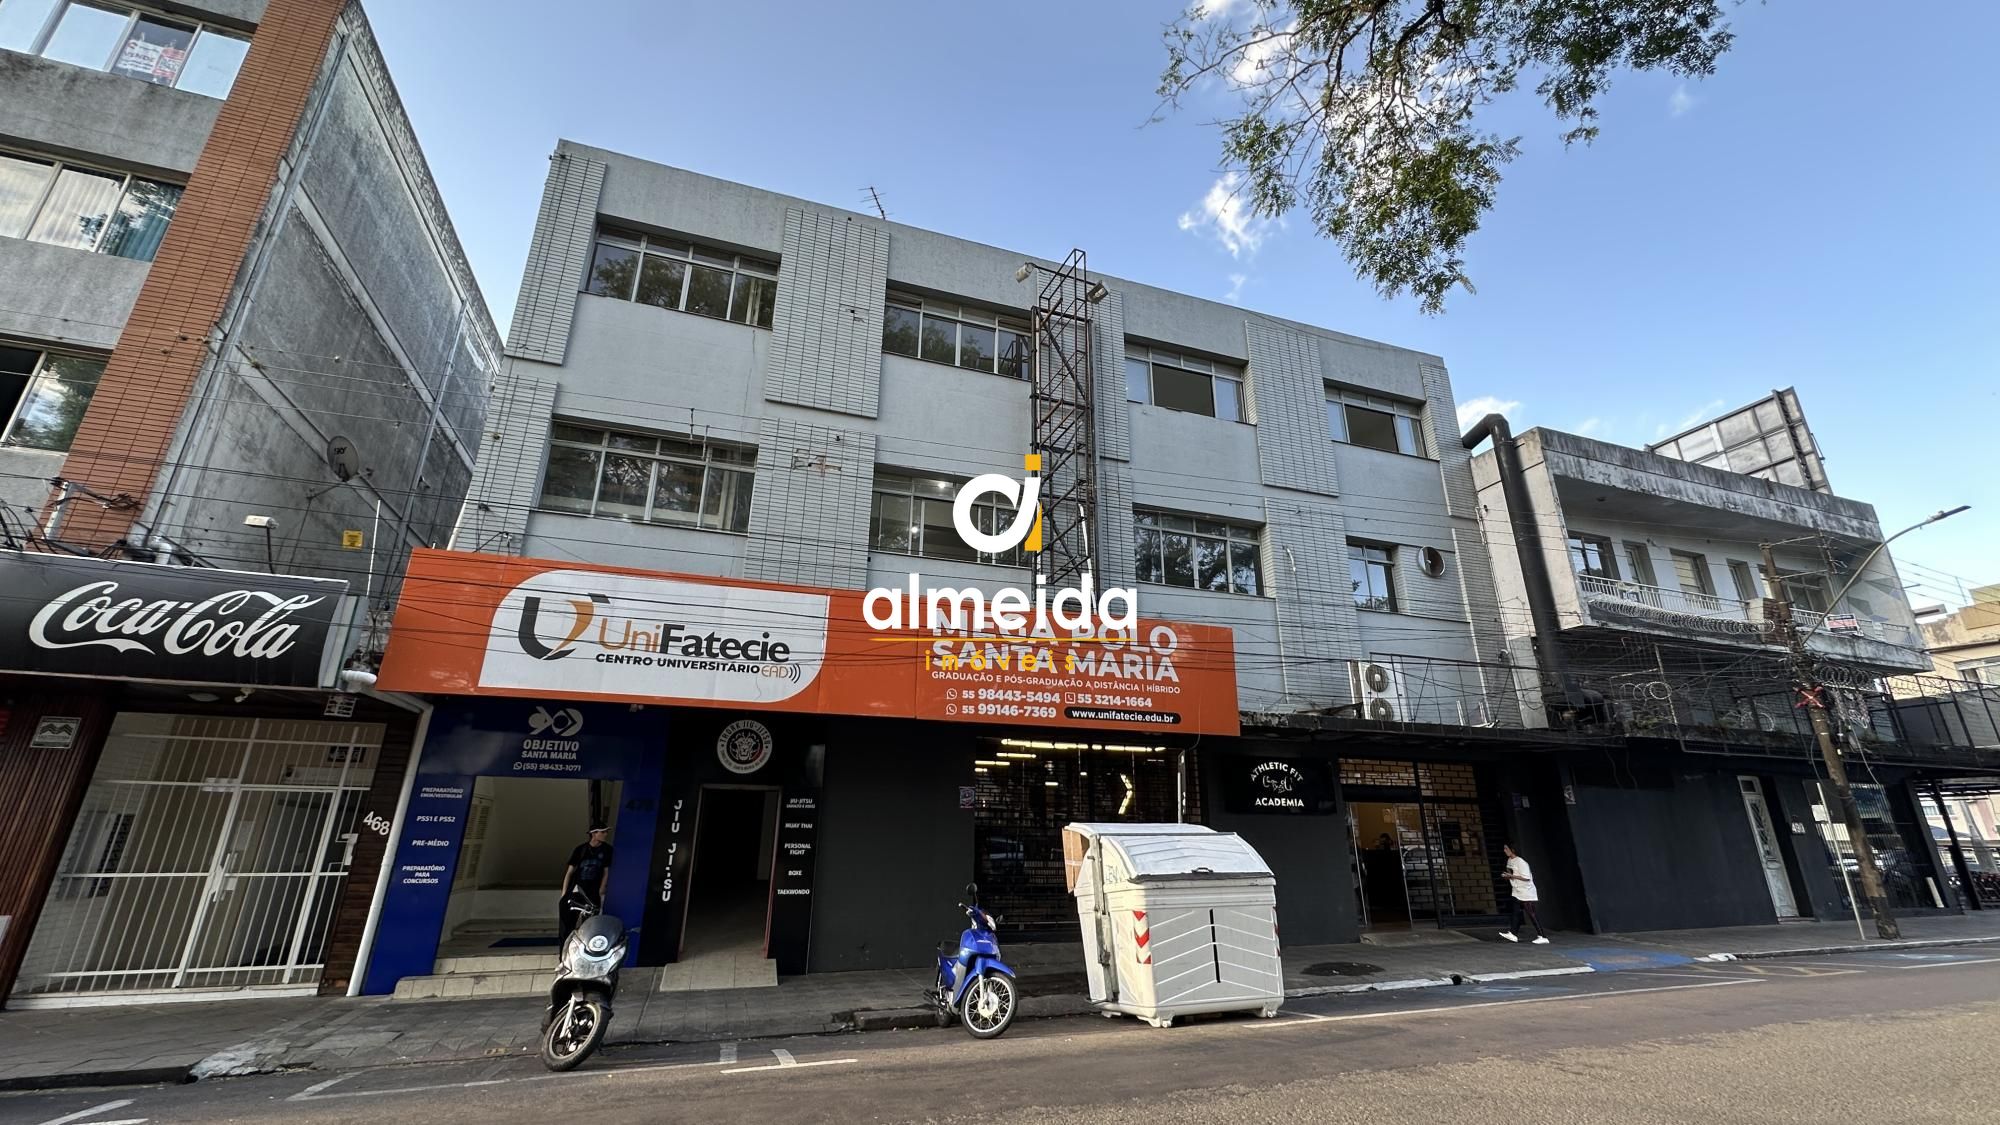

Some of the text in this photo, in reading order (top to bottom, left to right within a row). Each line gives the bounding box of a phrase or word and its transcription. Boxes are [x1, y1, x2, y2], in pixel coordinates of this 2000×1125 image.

[28, 580, 328, 660] Coca-Cola
[598, 617, 791, 663] UniFatecie
[595, 653, 789, 679] CENTRO UNIVERSITÁRIO EAD
[932, 640, 1180, 683] SANTA MARIA
[931, 671, 1181, 694] GRADUAÇÃO E PÓS-GRADUAÇÃO A DISTÂNCIA HÍBRIDO
[962, 688, 1061, 704] 55 98443-5494
[1077, 693, 1153, 708] 55 3214-1664
[961, 703, 1057, 718] 55 99146-7369
[1071, 709, 1174, 723] www.unifatecie.edu.br
[523, 739, 580, 752] OBJETIVO
[521, 751, 577, 760] SANTA MARIA
[1250, 761, 1304, 782] ATHLETIC FIT
[1254, 797, 1305, 807] ACADEMIA
[363, 811, 391, 836] 468
